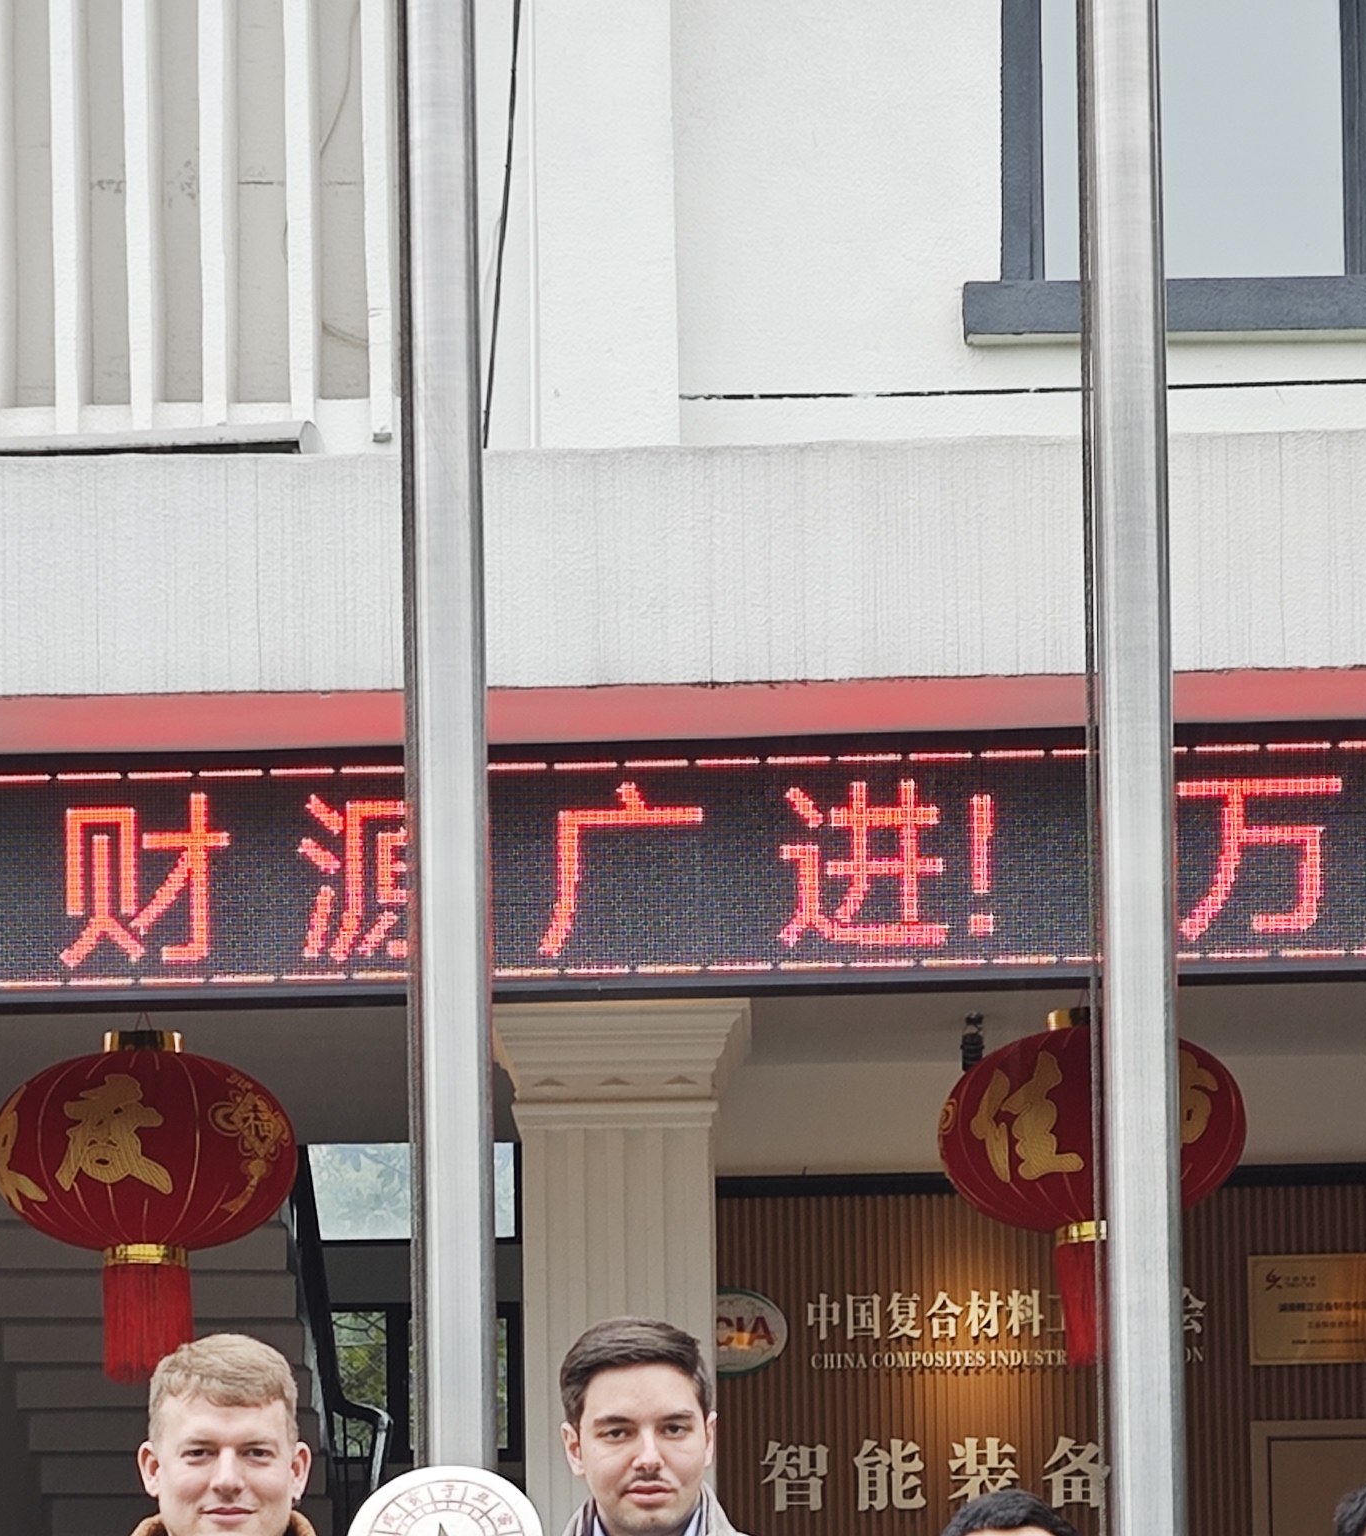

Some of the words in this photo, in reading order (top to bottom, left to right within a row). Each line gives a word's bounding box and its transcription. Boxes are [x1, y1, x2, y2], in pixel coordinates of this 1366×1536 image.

[59, 779, 995, 968] 财源广进!
[811, 1352, 867, 1369] CHINA
[871, 1350, 987, 1368] COMPOSITES
[990, 1348, 1068, 1367] INDUSTR
[441, 1484, 457, 1499] 子
[760, 1435, 1110, 1512] 智能装备
